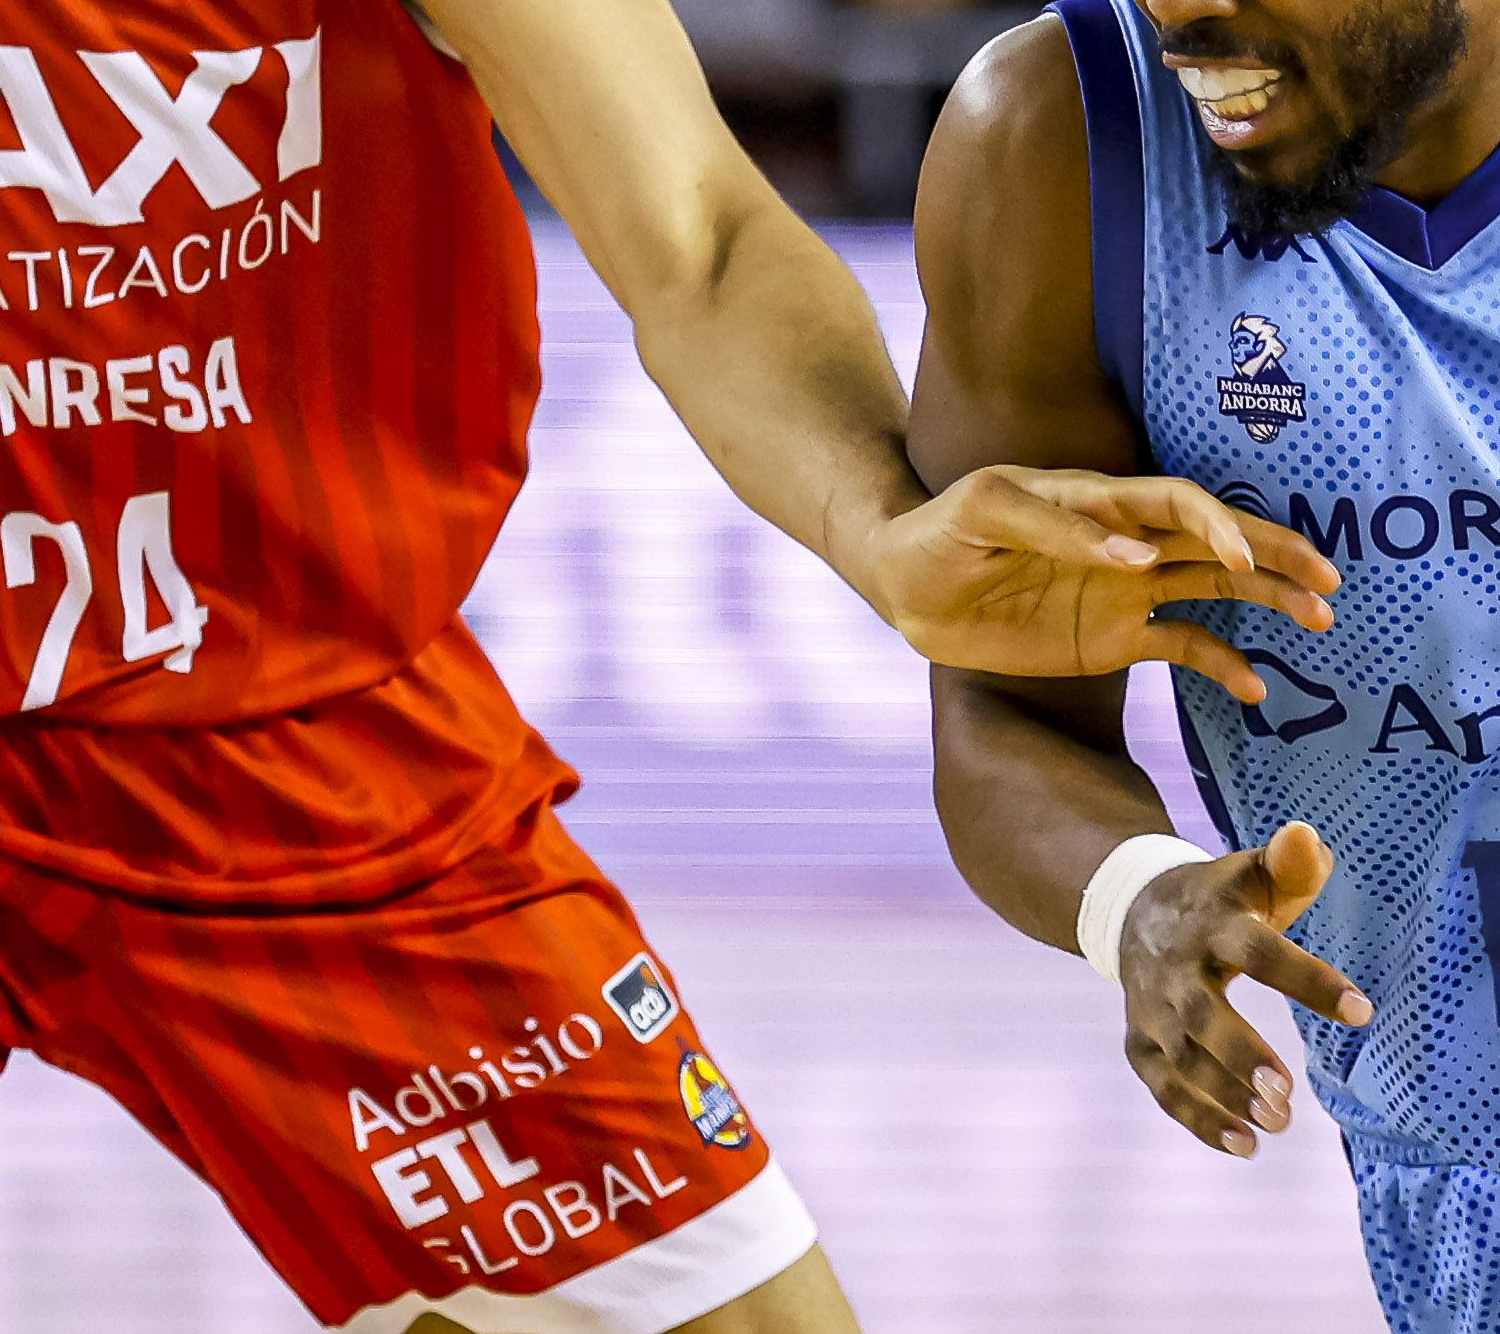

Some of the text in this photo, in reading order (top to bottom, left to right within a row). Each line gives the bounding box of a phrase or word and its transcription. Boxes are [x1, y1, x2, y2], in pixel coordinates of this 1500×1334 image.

[1220, 380, 1302, 397] MORABANC
[1221, 393, 1304, 417] ANDORRA
[346, 1012, 604, 1153] Adbisio
[371, 1117, 541, 1230] ETL
